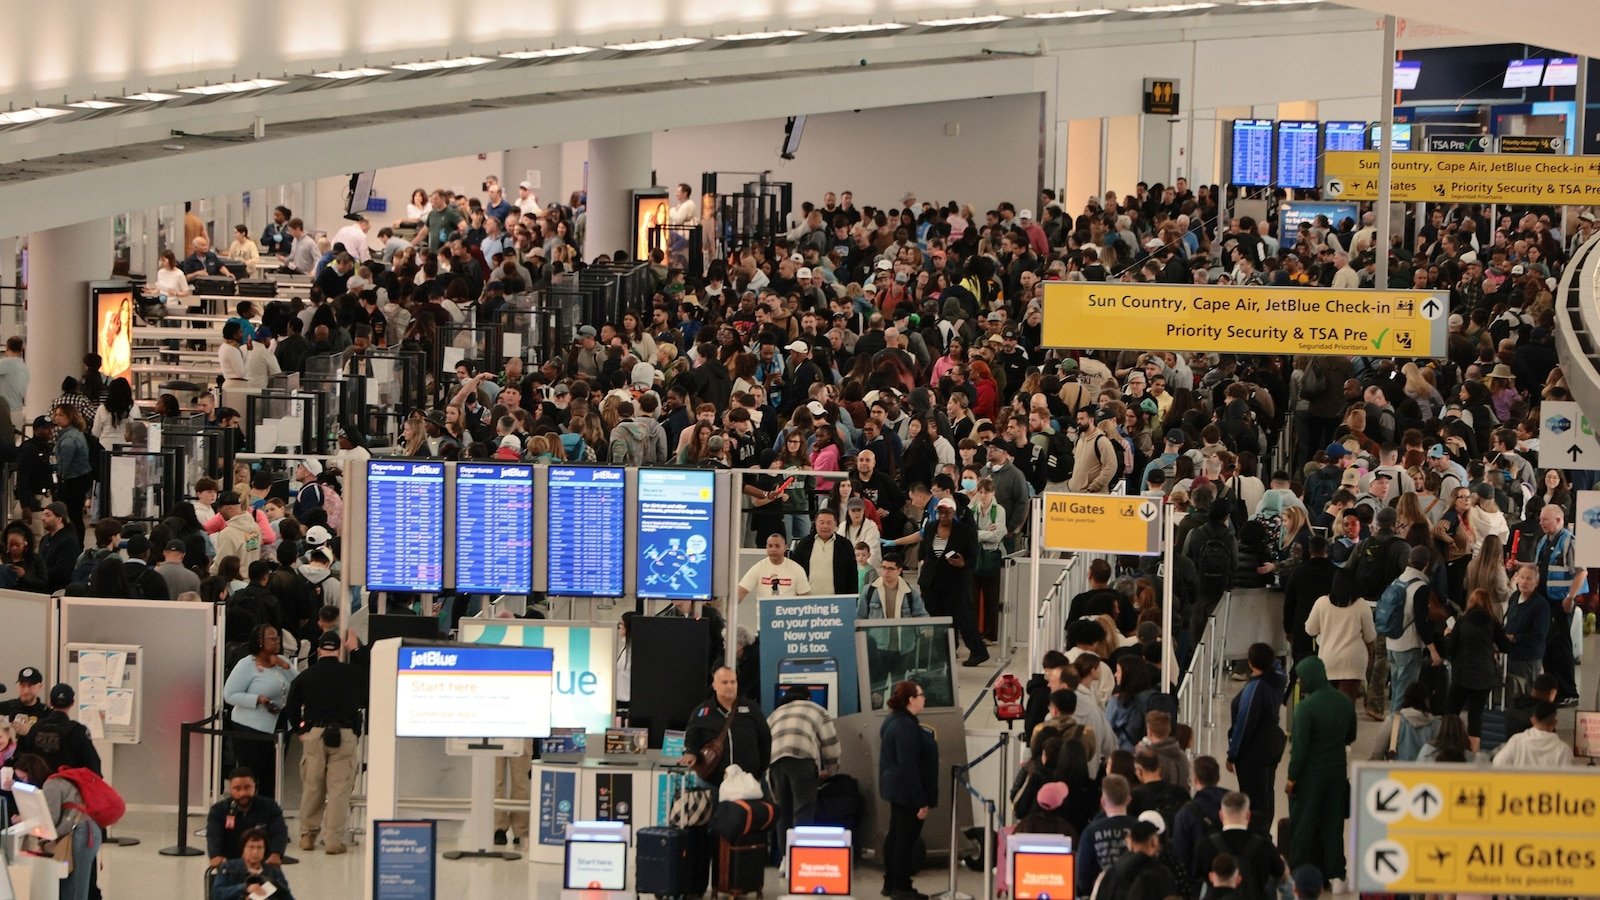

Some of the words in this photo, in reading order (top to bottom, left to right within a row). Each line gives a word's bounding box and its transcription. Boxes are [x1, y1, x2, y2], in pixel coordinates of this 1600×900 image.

[1432, 140, 1449, 150] TSA
[1450, 141, 1464, 150] Pre
[1359, 160, 1379, 169] Sun
[1391, 162, 1432, 173] ountry,
[1437, 161, 1465, 173] Cape
[1469, 162, 1487, 172] Air,
[1490, 162, 1531, 172] JetBlue
[1536, 163, 1584, 173] Check-in
[1390, 182, 1416, 191] ates
[1452, 183, 1493, 194] Priority
[1497, 183, 1543, 195] Security
[1547, 184, 1555, 193] &
[1560, 185, 1581, 194] TSA
[1088, 294, 1116, 307] Sun
[1121, 295, 1187, 313] Country,
[1193, 297, 1230, 314] Cape
[1235, 299, 1260, 313] Air,
[1265, 299, 1320, 313] JetBlue
[1326, 300, 1390, 314] Check-in
[1167, 324, 1222, 342] Priority
[1227, 326, 1288, 342] Security
[1293, 327, 1304, 339] &
[1309, 327, 1339, 340] TSA
[1344, 328, 1368, 340] Pre
[412, 465, 440, 475] jetBlue
[500, 467, 529, 478] jetBlue
[592, 470, 620, 481] jetBlue
[1050, 502, 1066, 512] All
[1070, 502, 1104, 514] Gates
[776, 604, 829, 615] Everything
[830, 604, 839, 614] is
[771, 620, 784, 628] on
[786, 619, 808, 629] your
[810, 617, 843, 628] phone.
[784, 631, 806, 640] Now
[808, 631, 832, 642] your
[787, 644, 798, 653] ID
[800, 643, 808, 653] is
[809, 643, 828, 653] too.
[410, 650, 458, 669] jetBlue
[411, 680, 444, 692] Start
[448, 681, 477, 693] here
[1498, 792, 1596, 816] JetBlue
[1467, 843, 1503, 866] All
[1515, 845, 1595, 868] Gates
[1467, 874, 1501, 884] Todas
[1505, 875, 1521, 884] las
[1526, 876, 1574, 887] puertas
